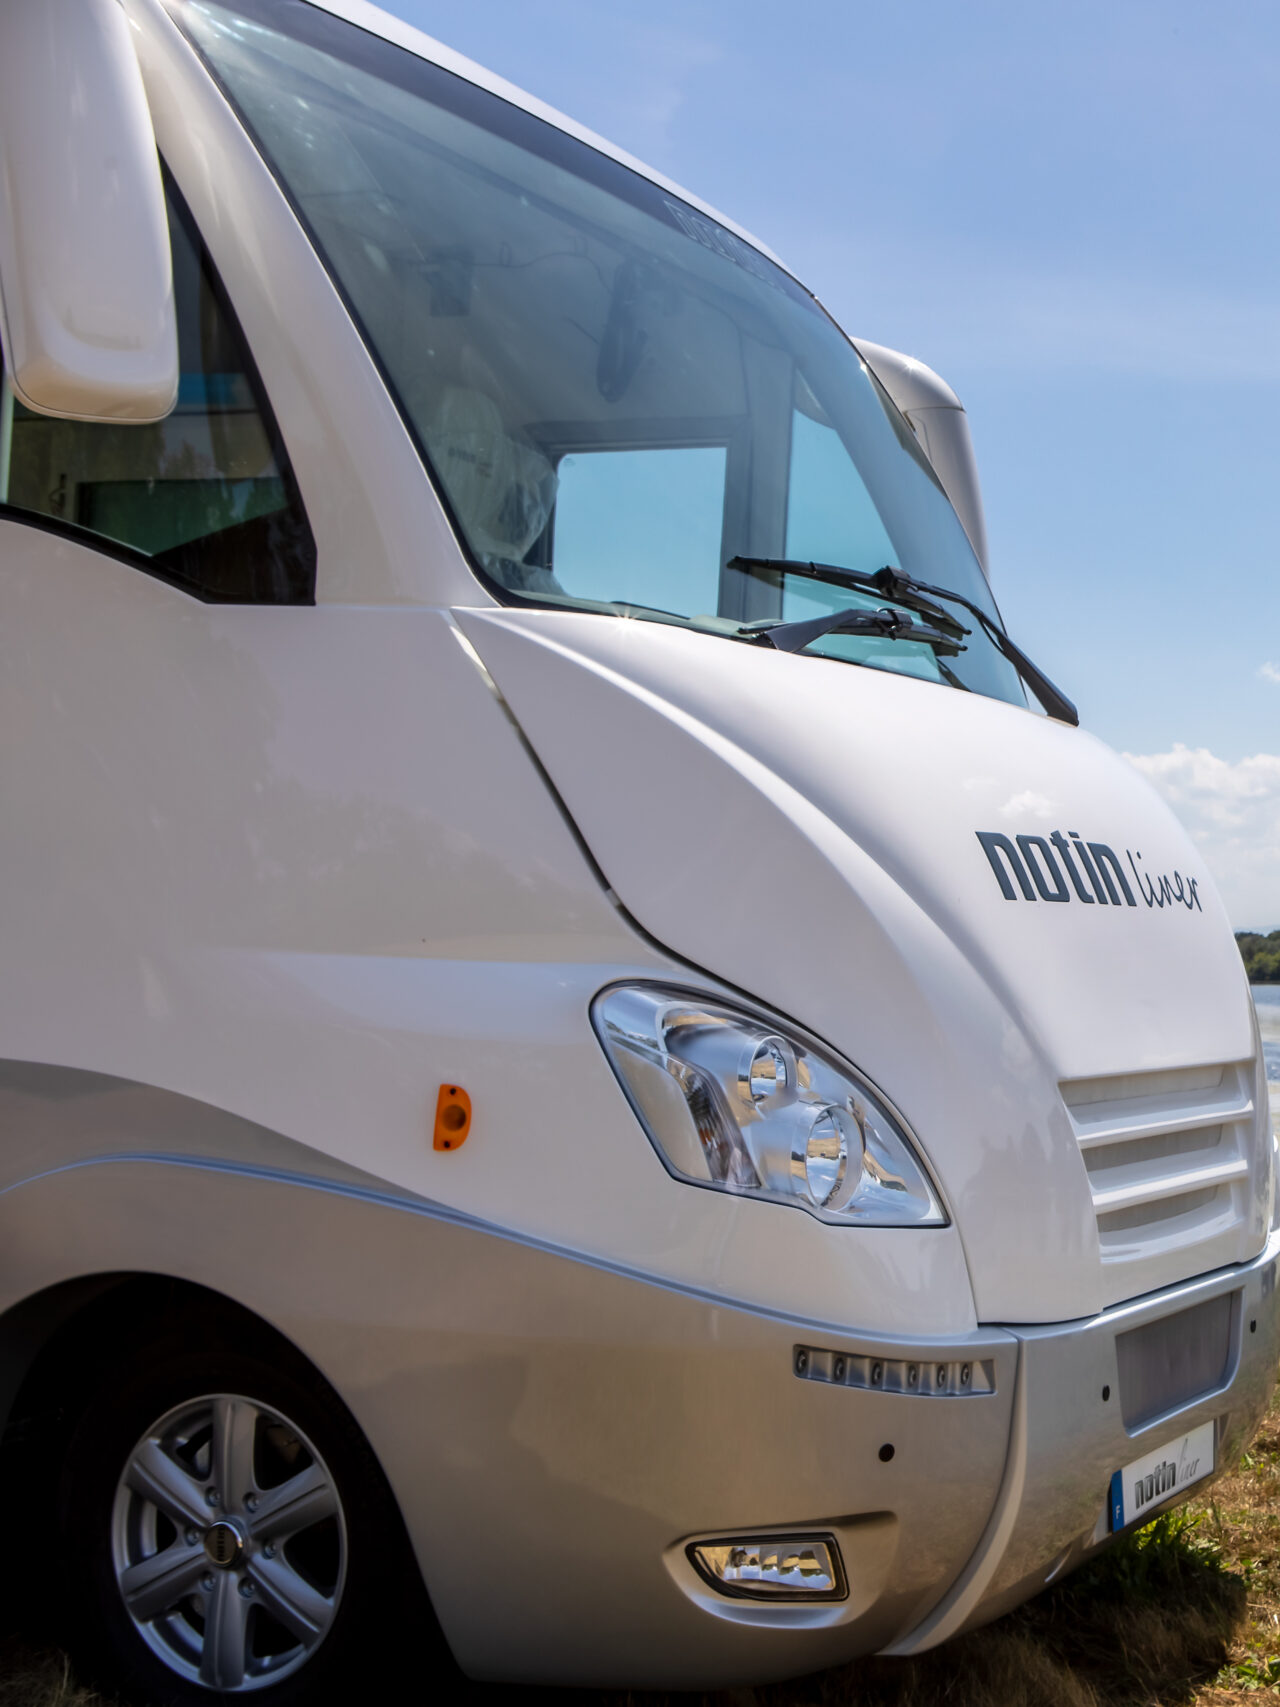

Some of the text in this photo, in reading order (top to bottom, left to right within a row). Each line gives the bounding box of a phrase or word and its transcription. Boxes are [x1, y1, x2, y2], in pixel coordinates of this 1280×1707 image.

[975, 830, 1203, 912] notin liner
[1135, 1461, 1176, 1509] notin
